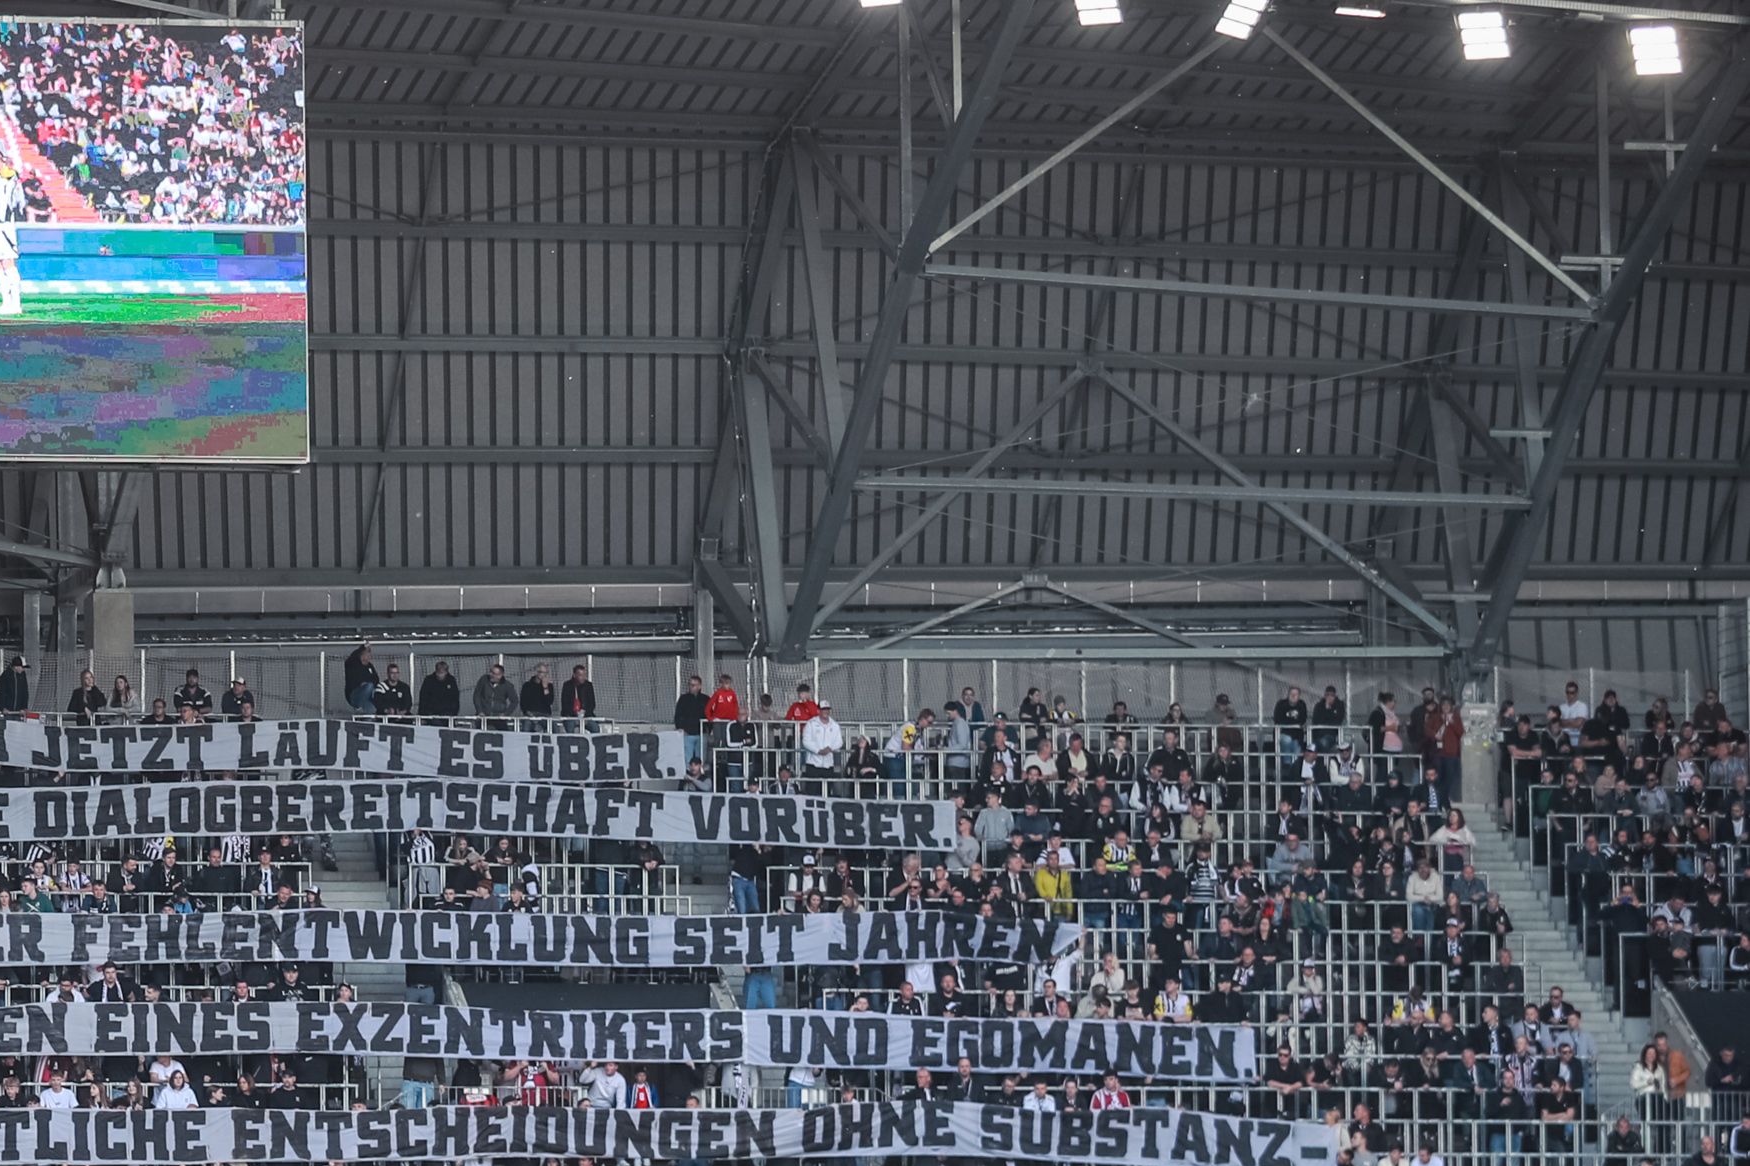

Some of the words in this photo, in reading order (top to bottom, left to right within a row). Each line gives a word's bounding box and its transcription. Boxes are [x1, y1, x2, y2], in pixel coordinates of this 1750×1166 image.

[33, 723, 212, 772] JETZT
[238, 719, 414, 770] LÄUFT
[438, 732, 503, 778] ES
[34, 782, 664, 842] DIALOGBEREITSCHAFT
[688, 796, 951, 848] VORÜBER.
[72, 910, 649, 964] FEHLENTWICKLUNG
[674, 913, 803, 963] SEIT
[829, 911, 1058, 964] JAHREN
[100, 1002, 272, 1052] EINES
[296, 1002, 745, 1062] EXZENTRIKERS
[767, 1014, 877, 1067] UND
[910, 1018, 1254, 1079] EGOMANEN.
[234, 1107, 777, 1160] ENTSCHEIDUNGEN
[805, 1104, 955, 1153] OHNE
